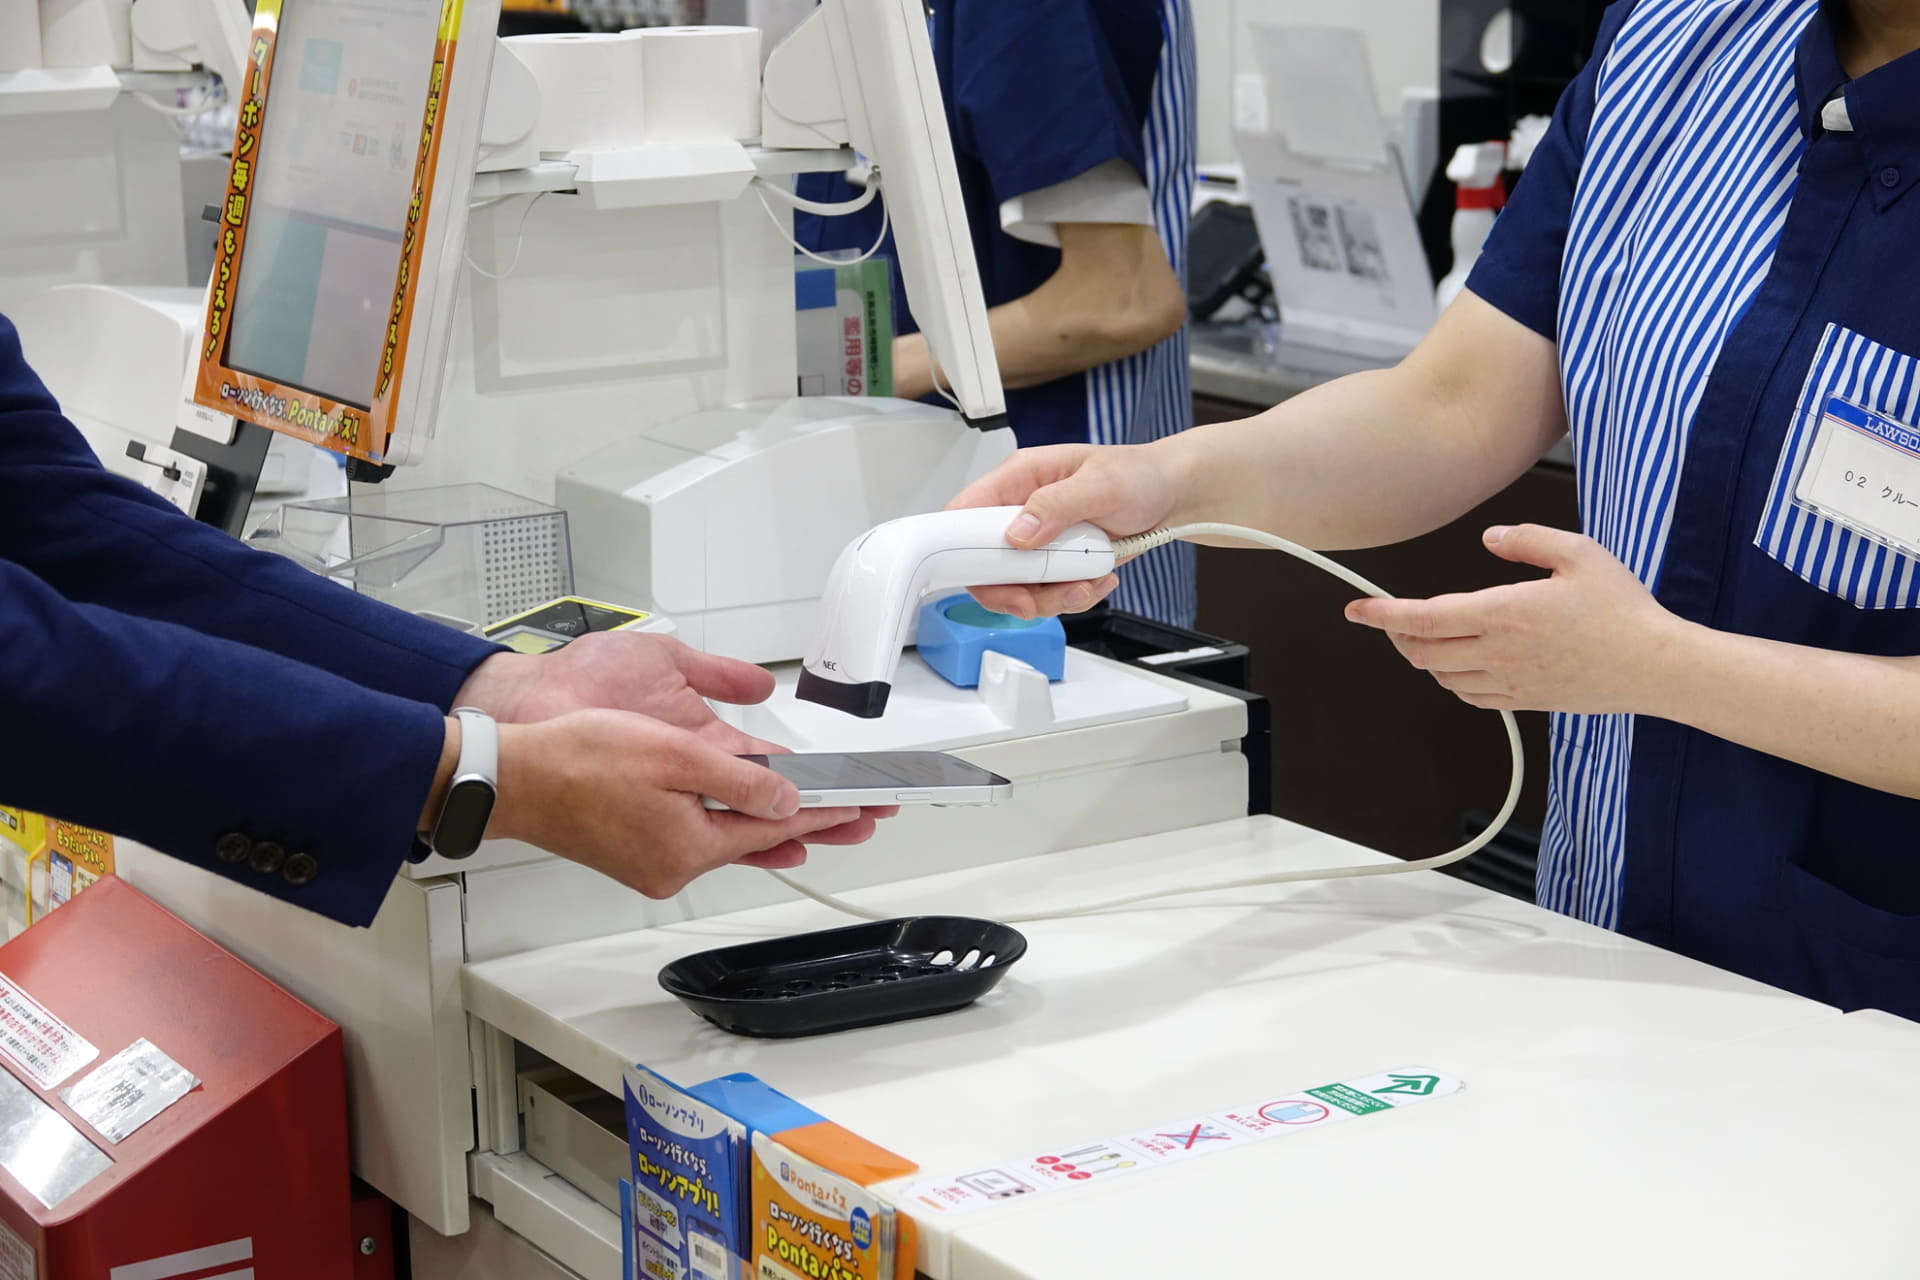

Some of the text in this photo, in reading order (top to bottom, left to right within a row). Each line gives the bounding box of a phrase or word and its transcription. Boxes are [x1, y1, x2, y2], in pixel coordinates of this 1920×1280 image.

[1864, 416, 1920, 453] LAWSO
[823, 660, 837, 672] NEC
[648, 1093, 704, 1133] ローソンアプリ
[639, 1127, 712, 1182] ローソン行くなら、
[637, 1151, 721, 1219] ローソンアプリ!
[790, 1169, 848, 1211] Pontaパス
[769, 1200, 858, 1269] ローソン行くなら、
